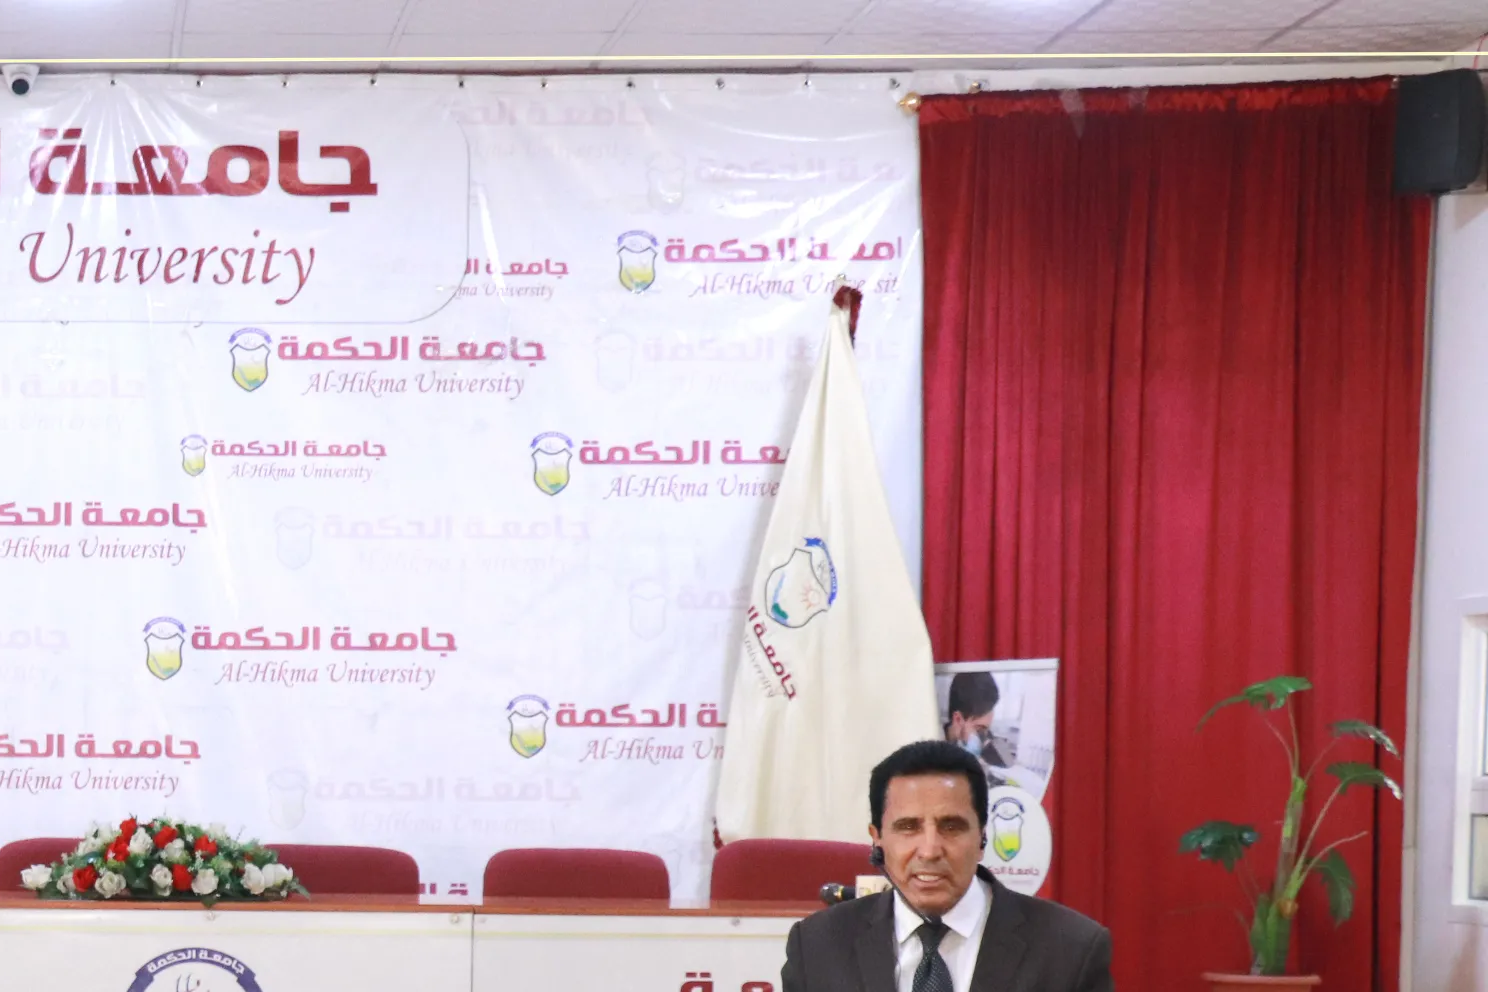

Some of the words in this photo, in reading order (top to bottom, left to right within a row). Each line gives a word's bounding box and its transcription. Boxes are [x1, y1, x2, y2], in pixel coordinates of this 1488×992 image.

[28, 128, 378, 212] جامعة
[807, 236, 903, 261] امعة
[18, 224, 315, 306] University
[689, 273, 795, 300] Al-Hikma
[278, 336, 409, 361] الحكمة
[419, 336, 546, 366] جامعة
[302, 370, 407, 397] Al-Hikma
[414, 370, 524, 400] University
[212, 440, 297, 456] الحكمة
[304, 440, 387, 460] جامعة
[579, 440, 710, 464] الحكمة
[228, 463, 298, 480] Al-Hikma
[300, 462, 373, 482] University
[603, 474, 708, 502] Al-Hikma
[717, 474, 780, 498] Unive
[82, 502, 207, 534] جامعة
[79, 536, 185, 567] University
[192, 626, 320, 650] الحكمة
[331, 626, 457, 657] جامعة
[215, 660, 319, 688] Al-Hikma
[326, 660, 435, 691] University
[743, 633, 775, 698] niversity
[555, 703, 687, 728] الحكمة
[75, 734, 201, 765] جامعة
[580, 737, 685, 765] Al-Hikma
[71, 767, 179, 798] University
[148, 950, 196, 973] الحكمة
[199, 950, 245, 975] جامعة
